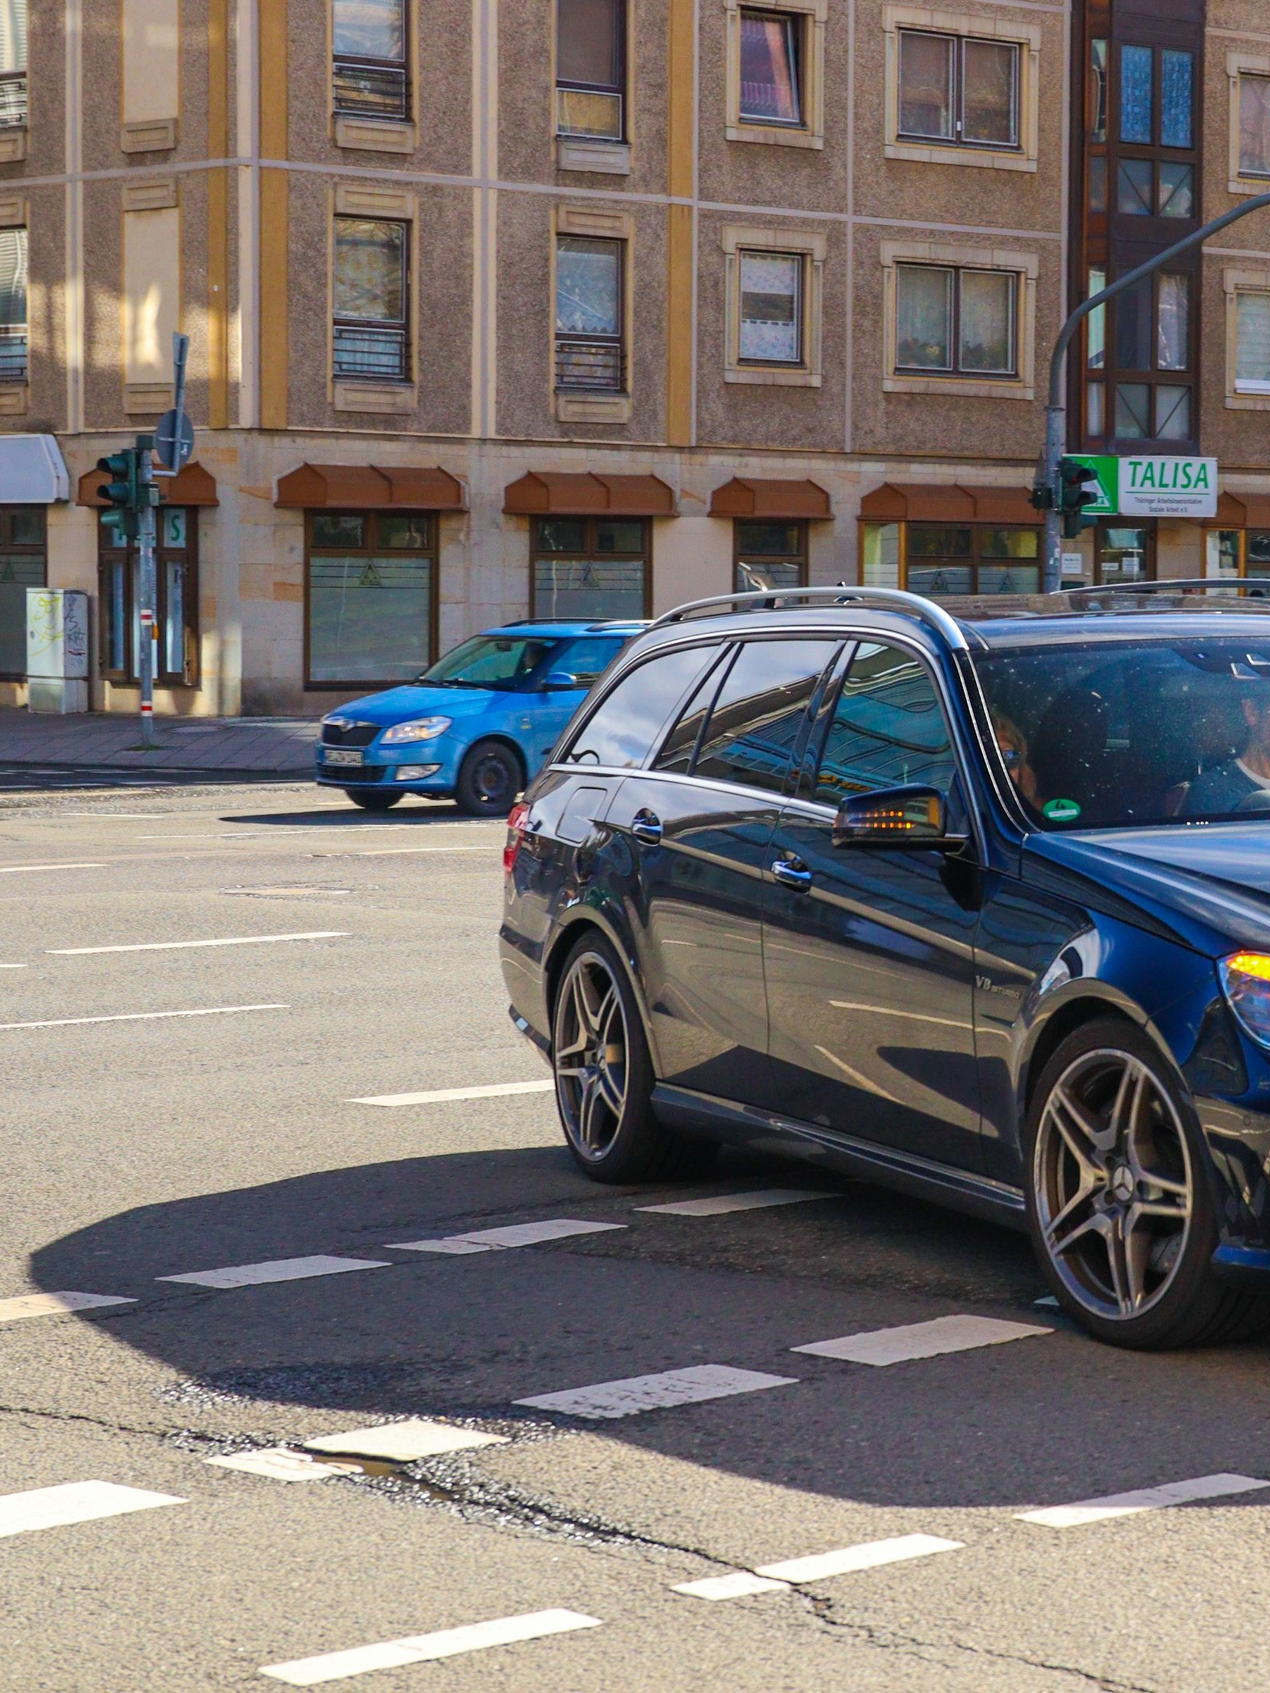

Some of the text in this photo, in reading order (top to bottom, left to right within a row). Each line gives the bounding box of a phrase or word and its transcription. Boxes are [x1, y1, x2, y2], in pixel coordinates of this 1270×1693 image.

[1128, 461, 1209, 489] TALISA
[1055, 799, 1066, 810] 4
[975, 975, 992, 991] V8
